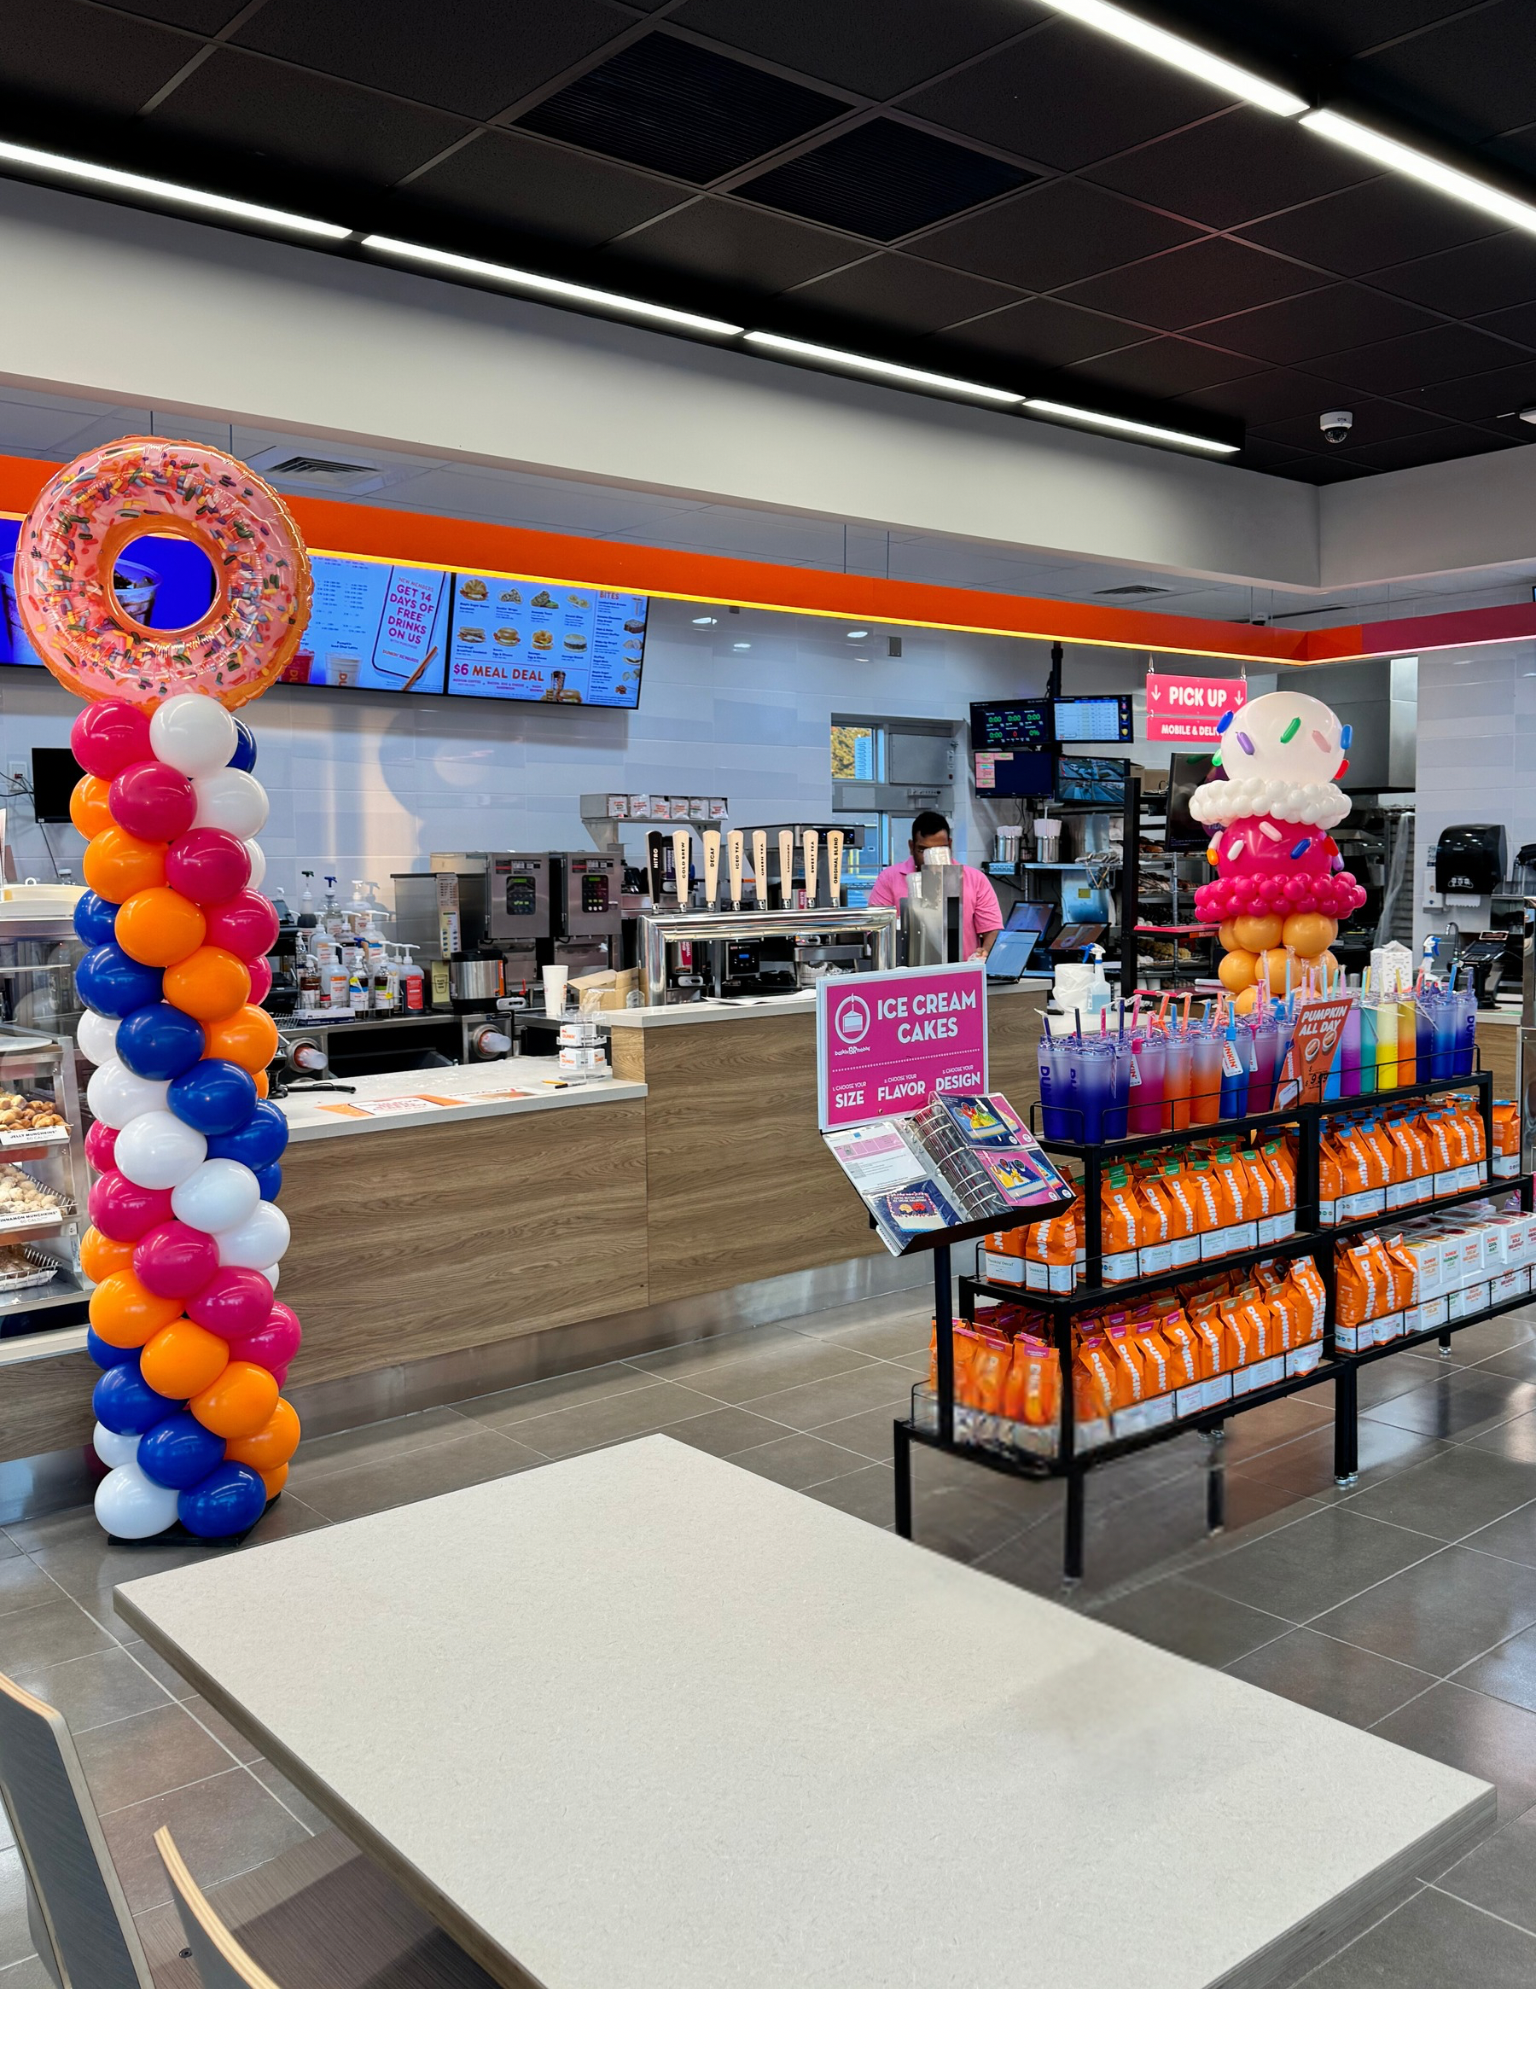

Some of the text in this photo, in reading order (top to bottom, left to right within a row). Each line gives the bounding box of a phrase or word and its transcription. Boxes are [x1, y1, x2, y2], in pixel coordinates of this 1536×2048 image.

[389, 592, 417, 609] DAYS
[419, 602, 435, 614] OF
[396, 584, 432, 602] GET 14
[387, 615, 427, 635] DRINKS
[388, 627, 422, 645] ON US
[453, 663, 544, 682] $6 MEAL DEAL
[1169, 686, 1228, 708] PICK UP
[1160, 724, 1191, 735] MOBILE
[1191, 725, 1198, 736] &
[877, 989, 977, 1021] ICE CREAM
[1301, 1005, 1348, 1023] PUMPKIN
[897, 1017, 959, 1044] CAKES
[1298, 1018, 1342, 1036] ALL DAY
[905, 1073, 917, 1081] YOUR
[935, 1072, 981, 1092] DESIGN
[946, 1066, 963, 1074] CHOOSE
[835, 1090, 865, 1109] SIZE
[836, 1083, 854, 1091] CHOOSE
[877, 1080, 926, 1102] FLAVOR
[1224, 1169, 1243, 1220] DUNKIN'
[1250, 1166, 1269, 1214] DUNKIN'
[1271, 1159, 1291, 1208] DUNKIN'
[1146, 1188, 1168, 1239] DUNKIN'
[1172, 1180, 1194, 1232] DUNKIN'
[1196, 1175, 1218, 1226] DUNKIN'
[1113, 1194, 1136, 1246] DUNKIN'
[1037, 1219, 1051, 1259] NKIN'
[1300, 1277, 1318, 1339] DUNKIN'
[1227, 1313, 1246, 1366] DUNKIN'
[1246, 1305, 1266, 1356] DUNKIN'
[1273, 1300, 1290, 1349] DUNKIN'
[1174, 1328, 1194, 1380] DUNKIN'
[1200, 1321, 1220, 1373] DUNKIN'
[1118, 1344, 1141, 1400] DUNKIN'
[1142, 1338, 1166, 1390] DUNKIN'
